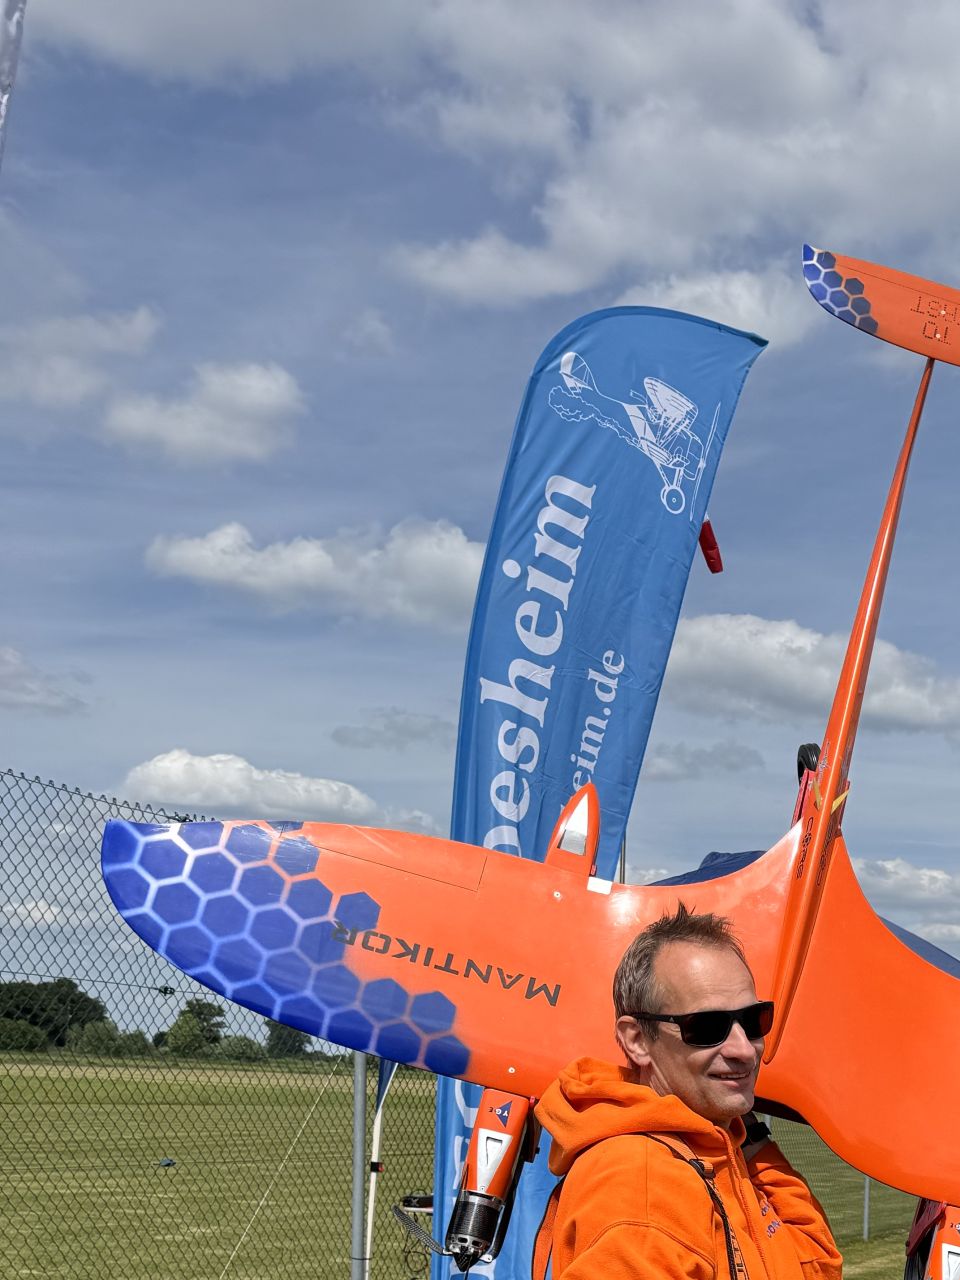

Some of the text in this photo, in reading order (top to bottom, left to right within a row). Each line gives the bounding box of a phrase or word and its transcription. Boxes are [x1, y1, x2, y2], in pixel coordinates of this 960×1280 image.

[562, 648, 626, 812] eim.de
[331, 919, 562, 1007] MANTIKOR
[488, 1107, 508, 1117] YGE
